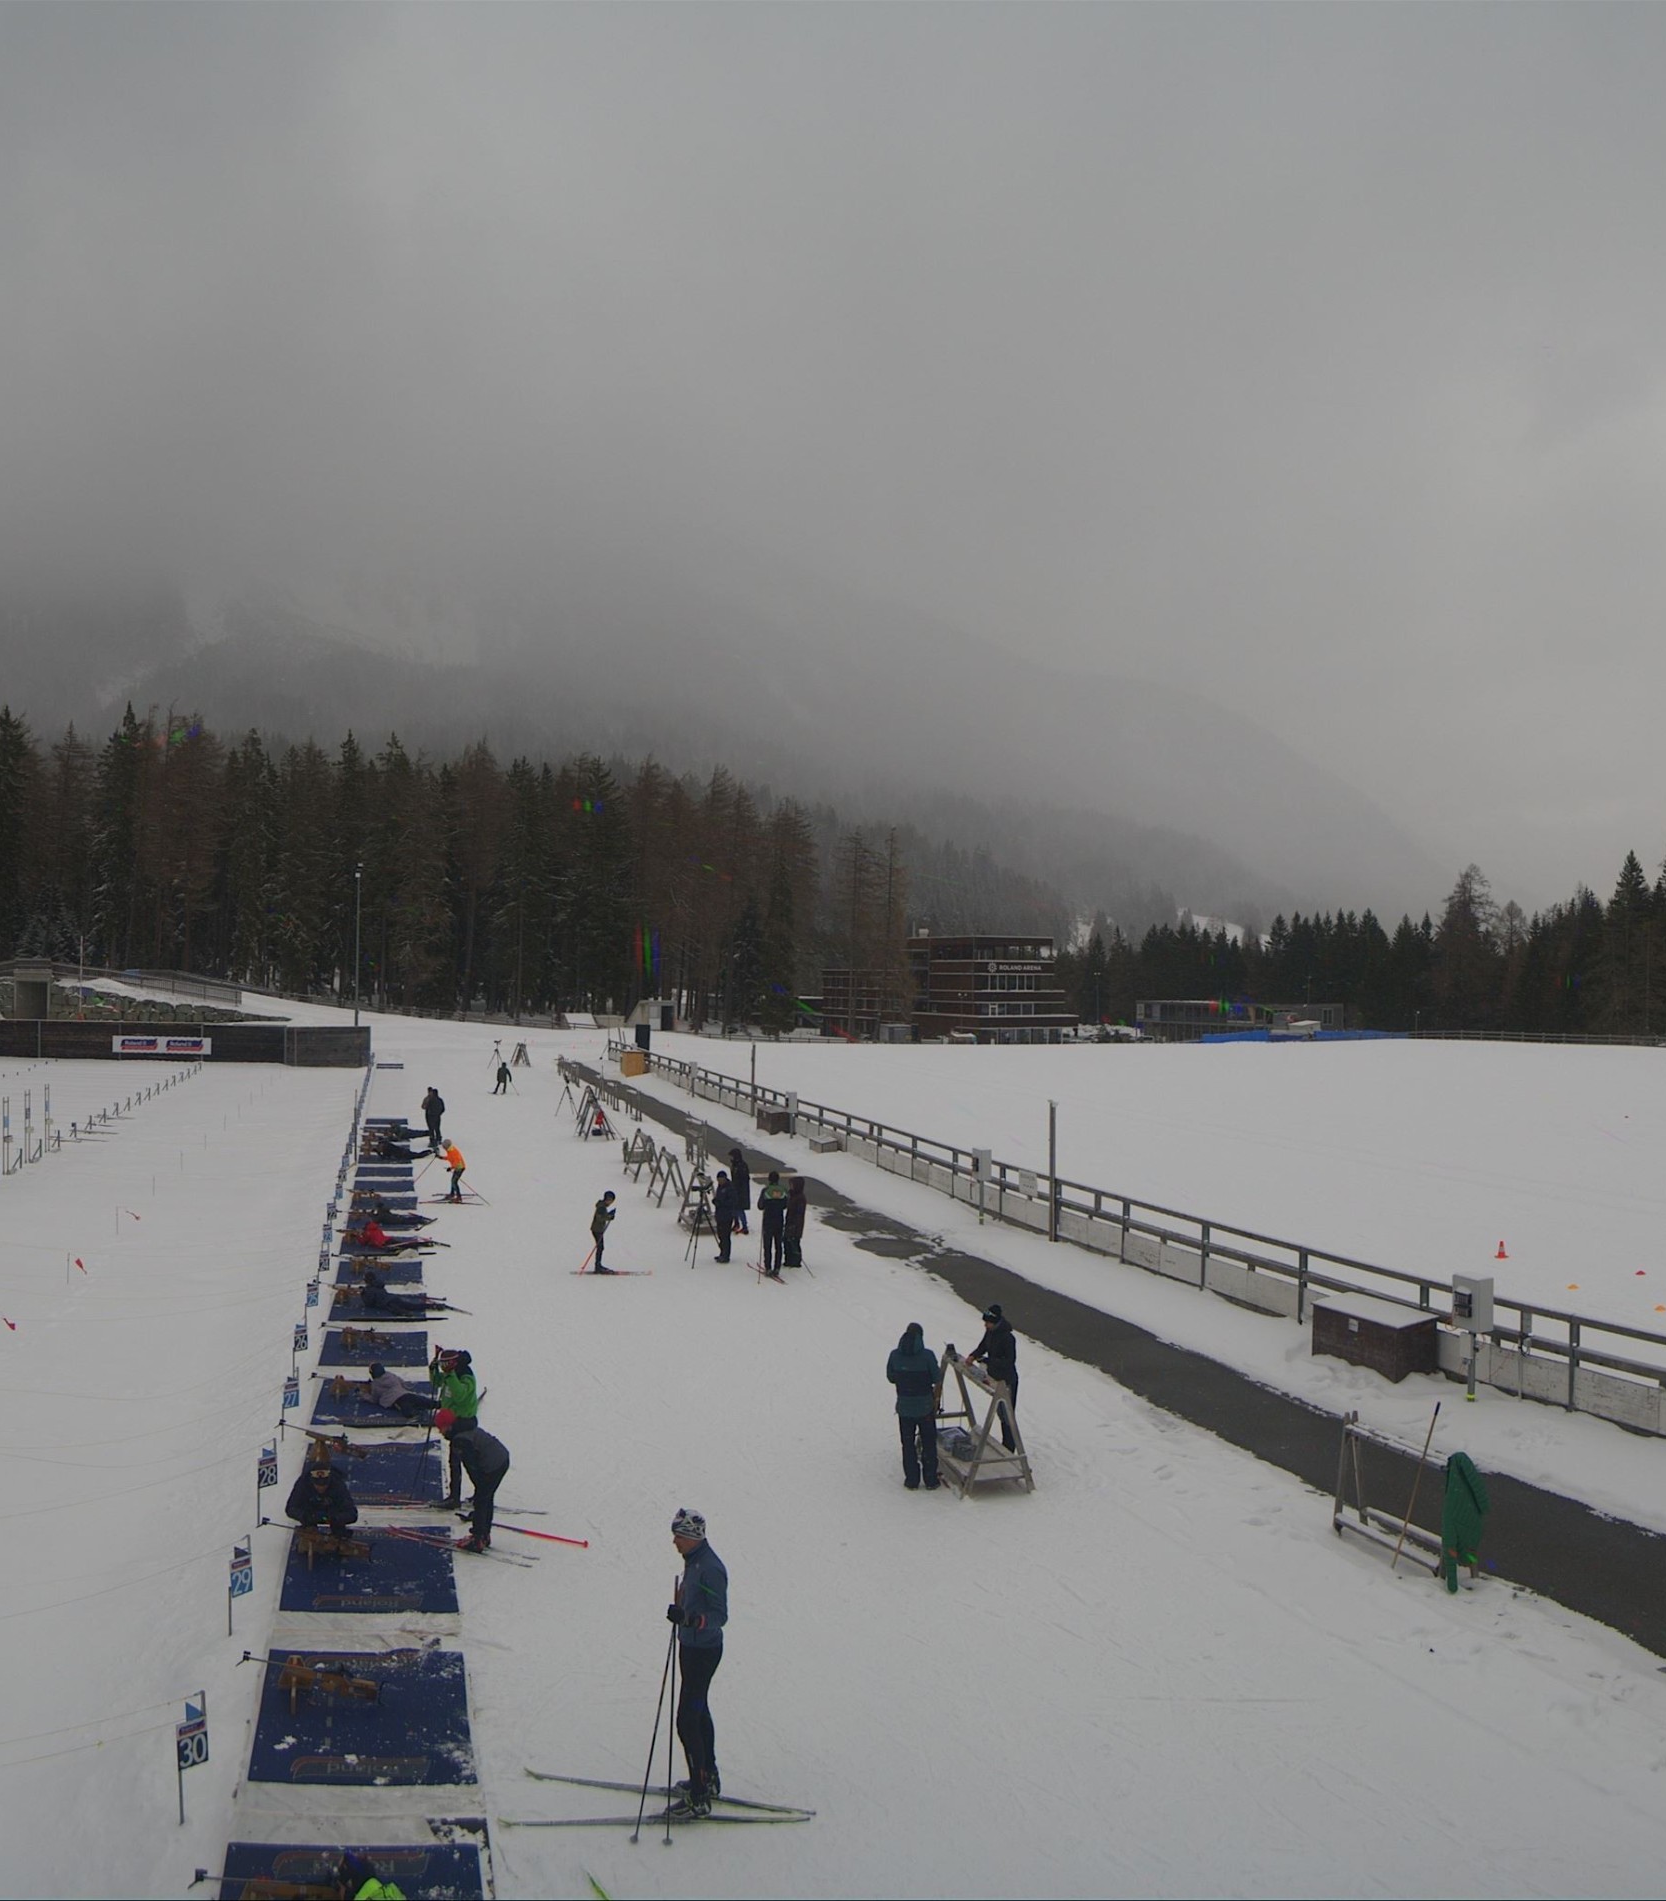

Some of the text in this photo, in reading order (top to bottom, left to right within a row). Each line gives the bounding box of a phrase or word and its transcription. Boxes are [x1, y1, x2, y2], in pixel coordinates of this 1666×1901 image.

[308, 1294, 318, 1305] 25
[295, 1336, 306, 1350] 26
[285, 1391, 297, 1407] 27
[259, 1465, 276, 1489] 28
[232, 1569, 250, 1595] 29
